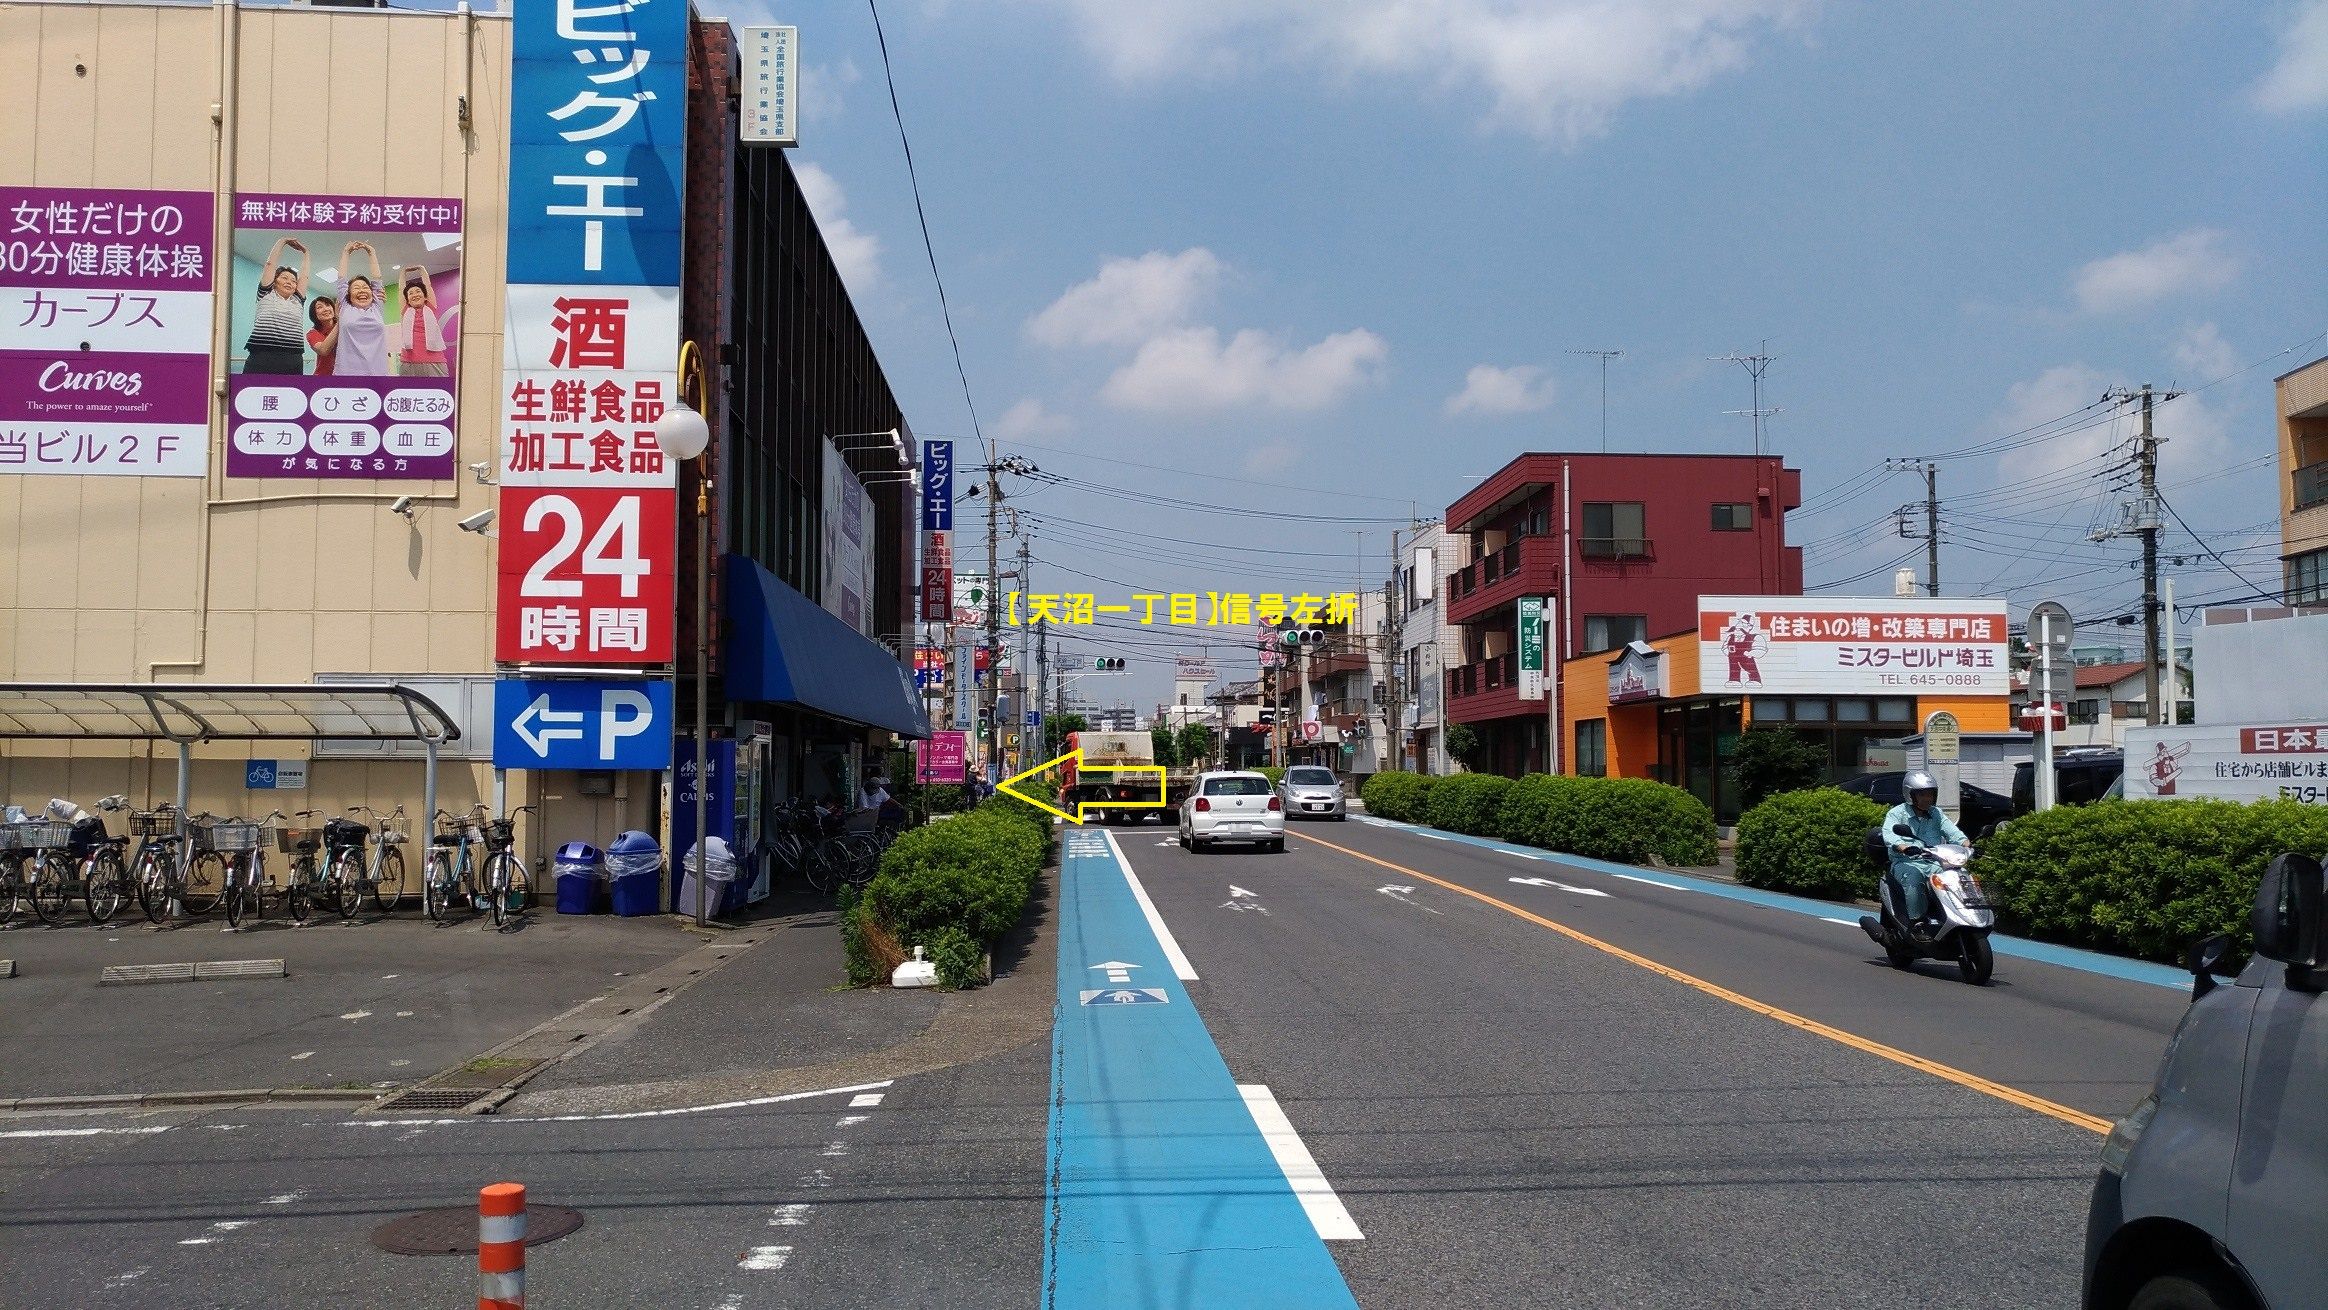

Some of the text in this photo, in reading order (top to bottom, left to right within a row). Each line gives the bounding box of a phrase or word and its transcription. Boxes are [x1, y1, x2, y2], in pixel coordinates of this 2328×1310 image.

[10, 199, 183, 236] 女性だけの
[241, 200, 458, 226] 無料体験予約受付中!
[19, 290, 165, 328] カーブス
[548, 295, 629, 370] 酒
[38, 360, 142, 396] Curves
[26, 401, 43, 410] The
[46, 403, 73, 412] power
[115, 403, 149, 413] yourself
[262, 395, 279, 411] 腰
[324, 396, 368, 412] ひざ
[387, 397, 451, 413] お腹たるみ
[510, 378, 665, 424] 生鮮食品
[248, 430, 293, 446] 体力
[323, 431, 367, 447] 体重
[397, 431, 441, 447] 血圧
[508, 427, 664, 474] 加工食品
[282, 457, 408, 471] が気になる方
[519, 494, 651, 598] 24
[931, 532, 945, 547] 酒
[923, 547, 951, 557] 生鮮食品
[923, 556, 951, 565] 加工食品
[928, 569, 945, 585] 24
[929, 586, 945, 619] 時間
[520, 604, 648, 652] 時間
[1770, 616, 1991, 640] 住まいの増・改築専門店
[1523, 627, 1533, 669] 防災システム
[1910, 674, 1981, 685] 645-0888
[600, 689, 653, 761] P
